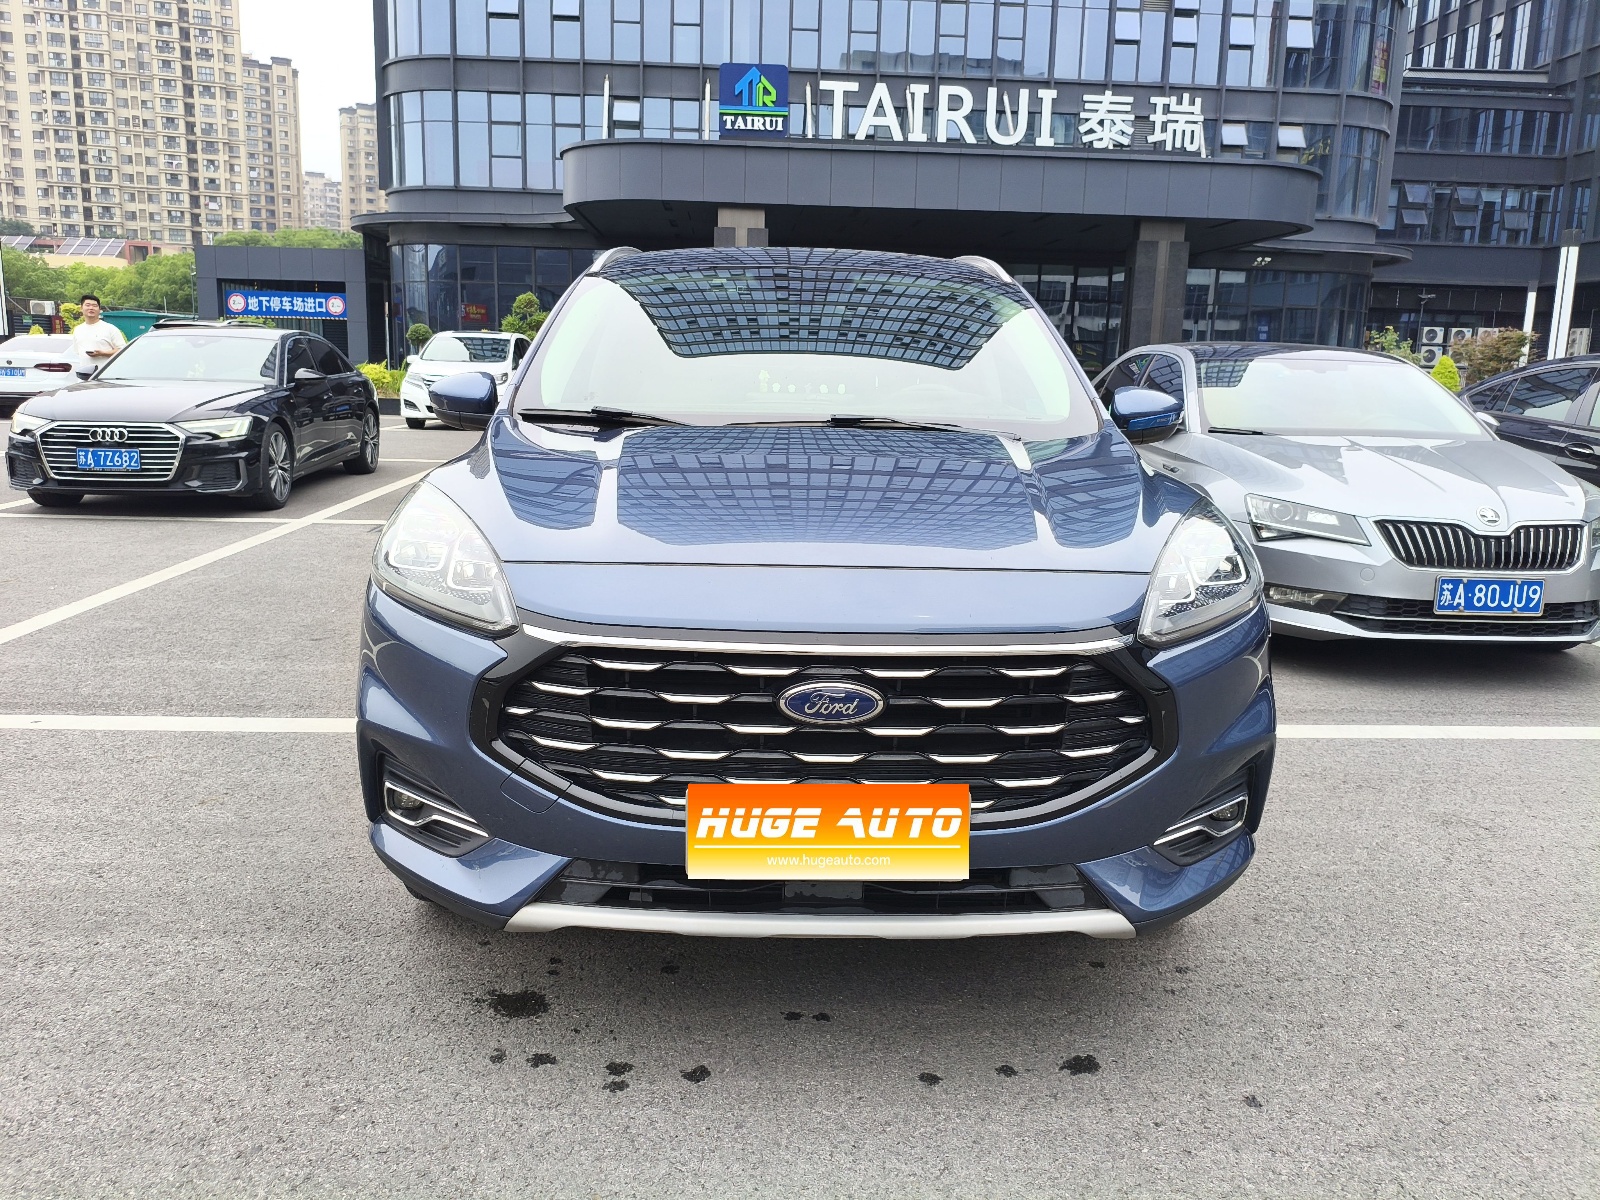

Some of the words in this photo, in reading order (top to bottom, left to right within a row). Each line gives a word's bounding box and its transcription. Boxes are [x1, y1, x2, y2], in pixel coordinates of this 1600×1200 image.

[723, 115, 784, 131] TAIRUI
[819, 81, 1057, 147] TAIRUI
[1078, 90, 1205, 153] 泰瑞
[247, 295, 327, 313] 地下停车场进口
[804, 691, 860, 714] Ford
